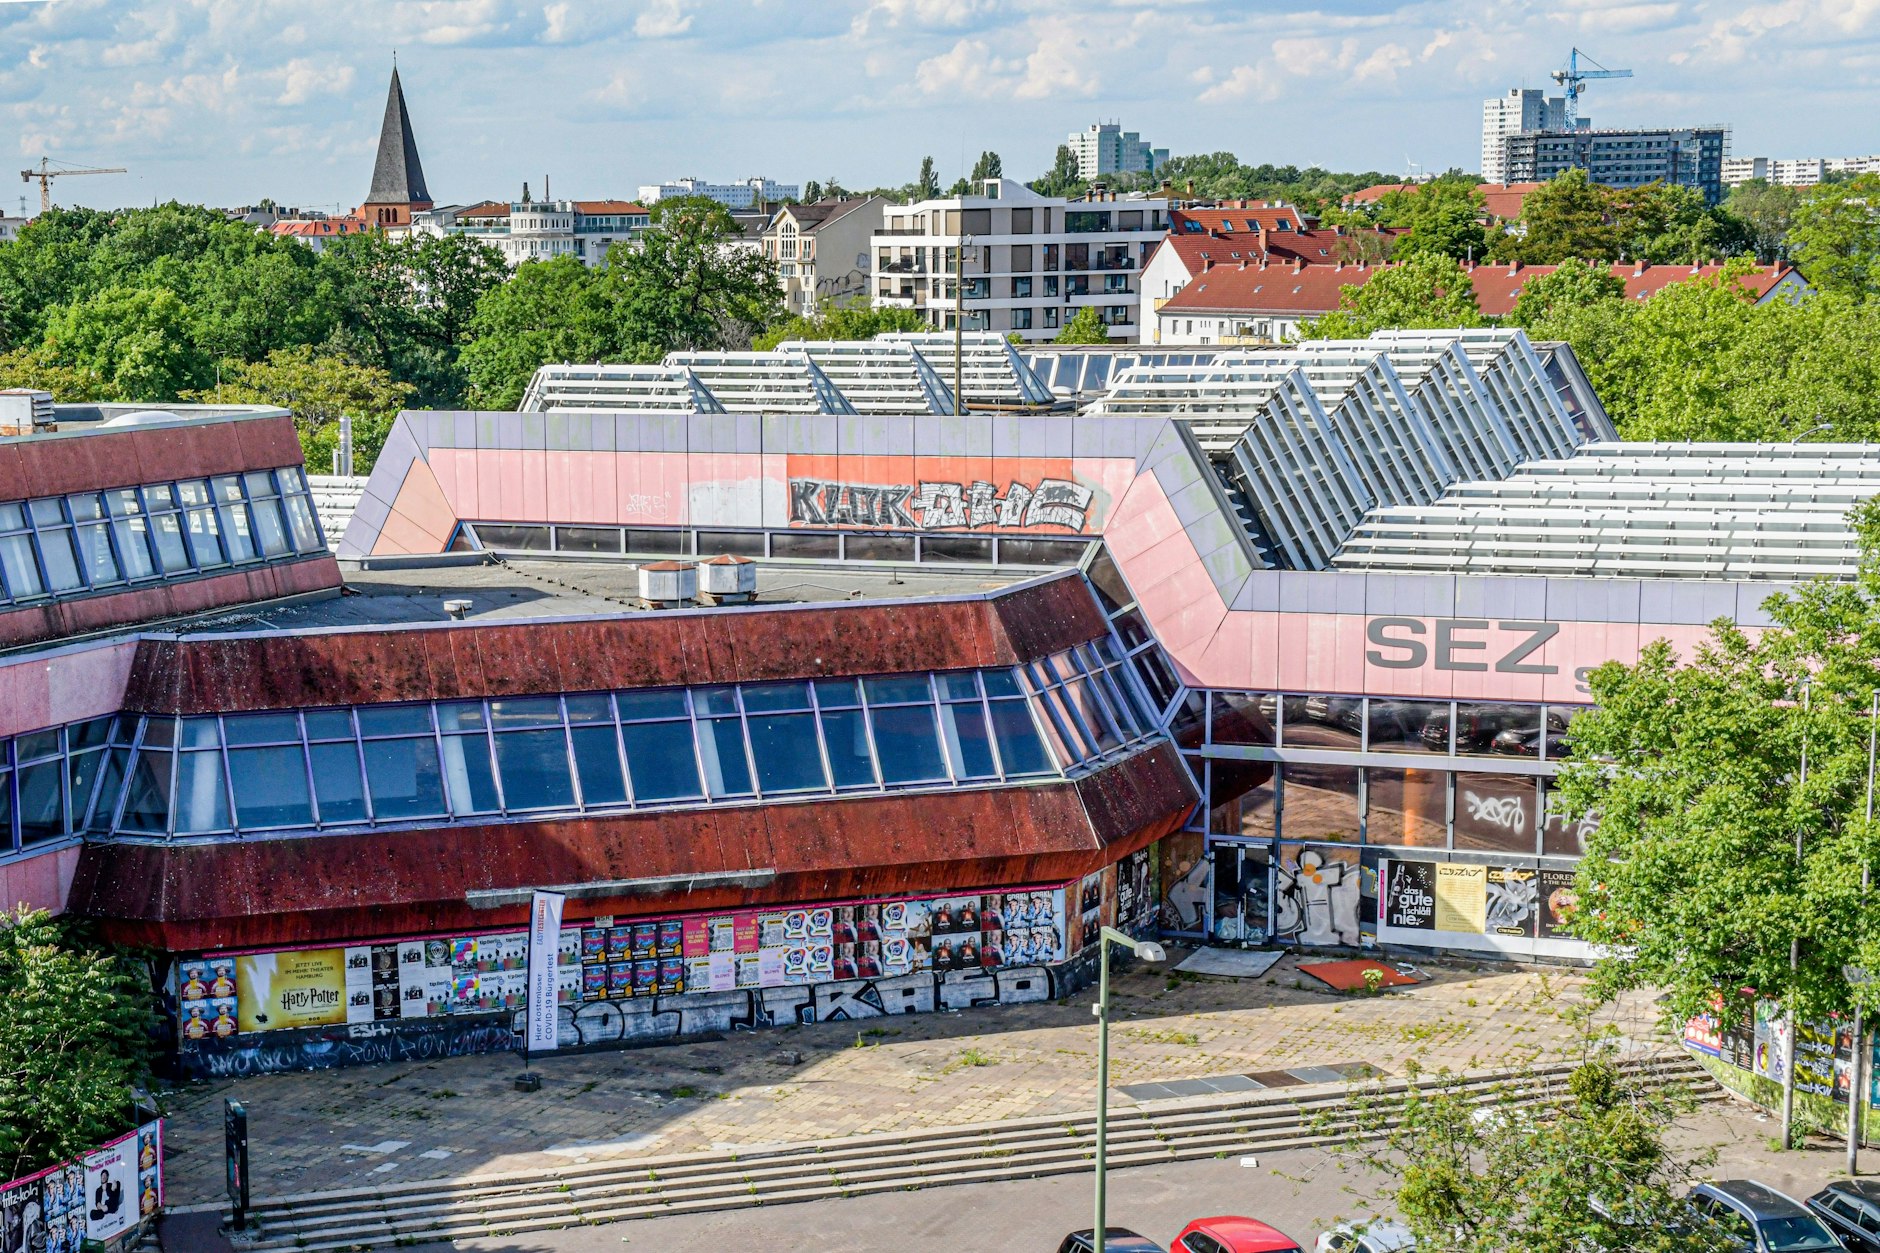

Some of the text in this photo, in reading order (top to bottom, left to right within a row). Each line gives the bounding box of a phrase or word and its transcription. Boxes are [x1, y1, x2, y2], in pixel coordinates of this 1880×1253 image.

[1366, 617, 1560, 675] SEZ
[1399, 890, 1433, 908] gute
[1403, 886, 1419, 895] das
[1393, 908, 1420, 925] nie.
[281, 988, 340, 1010] Harry Potter
[545, 953, 555, 1040] COVID-19 Bürgertest
[1812, 1041, 1835, 1055] HKW
[1810, 1082, 1833, 1096] HKW
